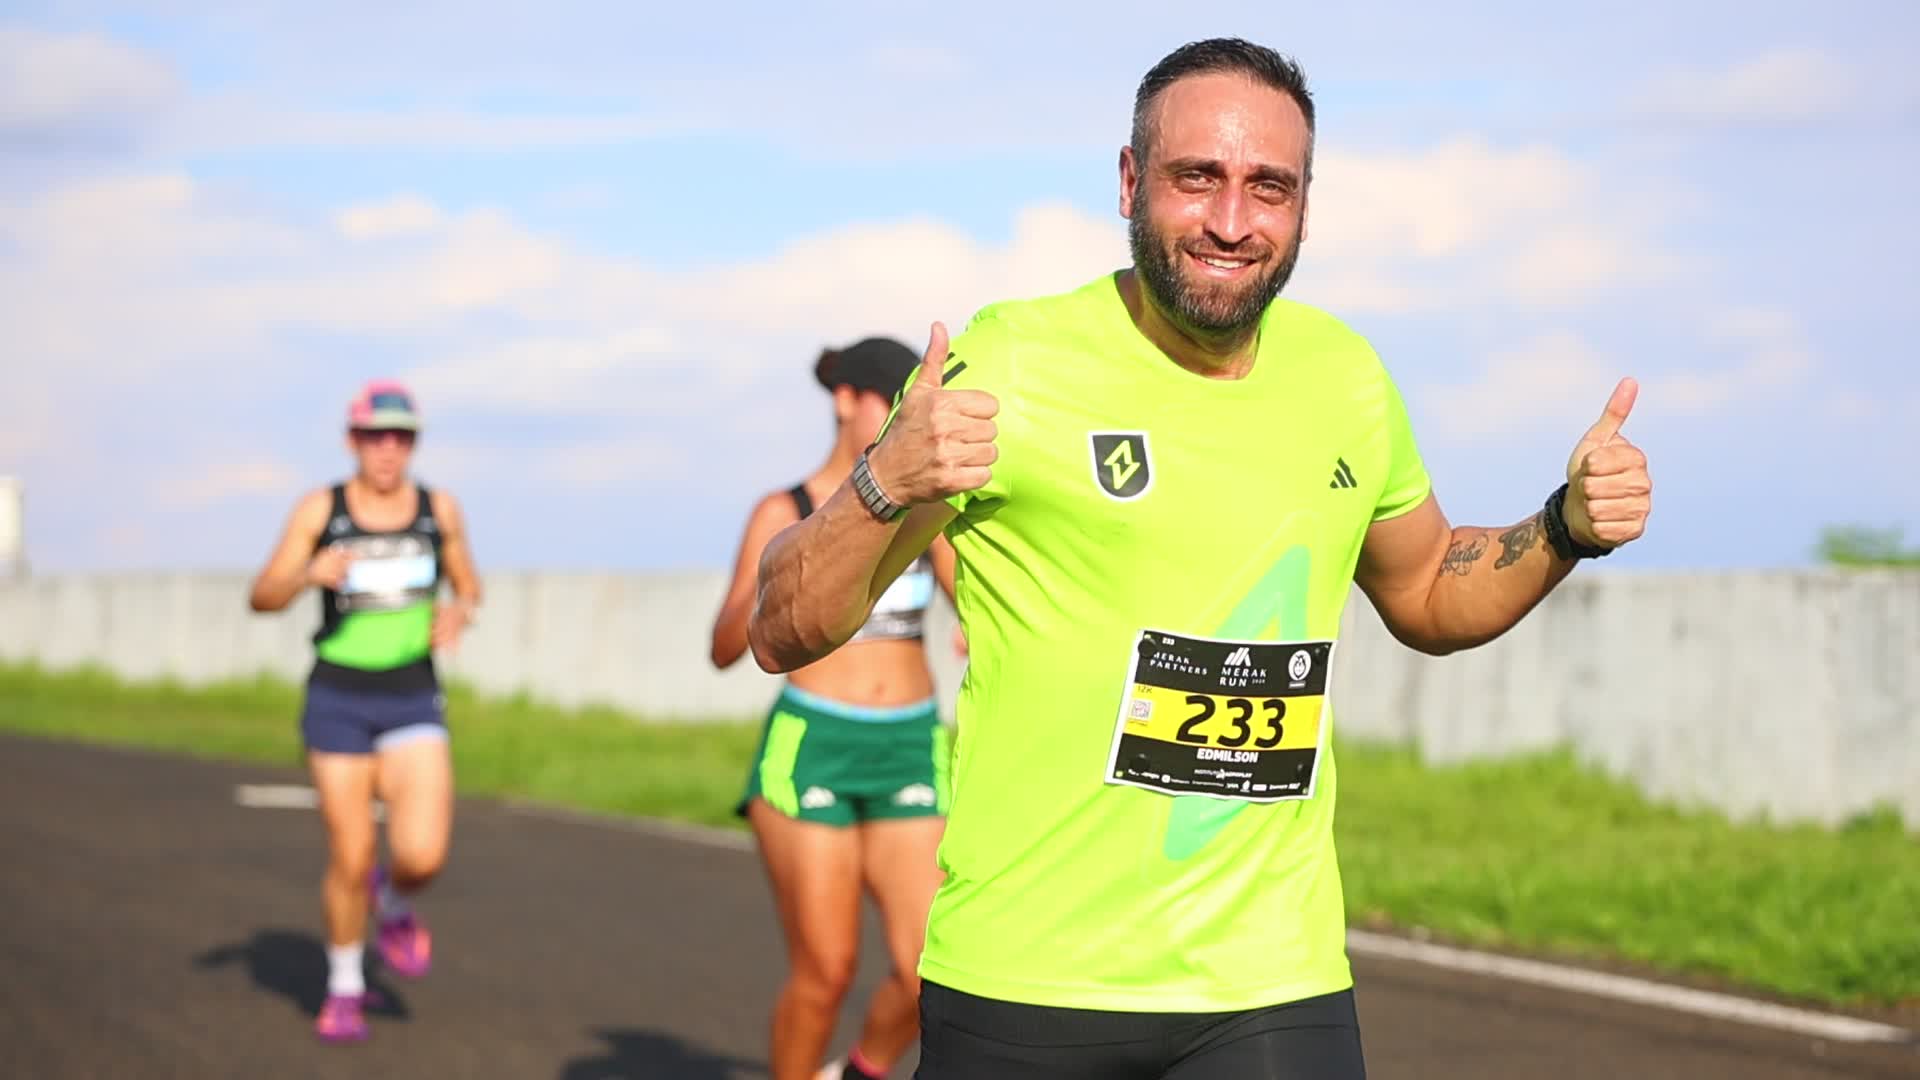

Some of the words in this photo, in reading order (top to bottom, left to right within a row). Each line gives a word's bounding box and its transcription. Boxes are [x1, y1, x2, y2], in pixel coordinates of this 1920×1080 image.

[1150, 659, 1207, 675] PARTNERS
[1221, 667, 1267, 678] MERAK
[1219, 677, 1247, 687] RUN
[1175, 694, 1286, 749] 233
[1197, 748, 1259, 763] EDMILSON
